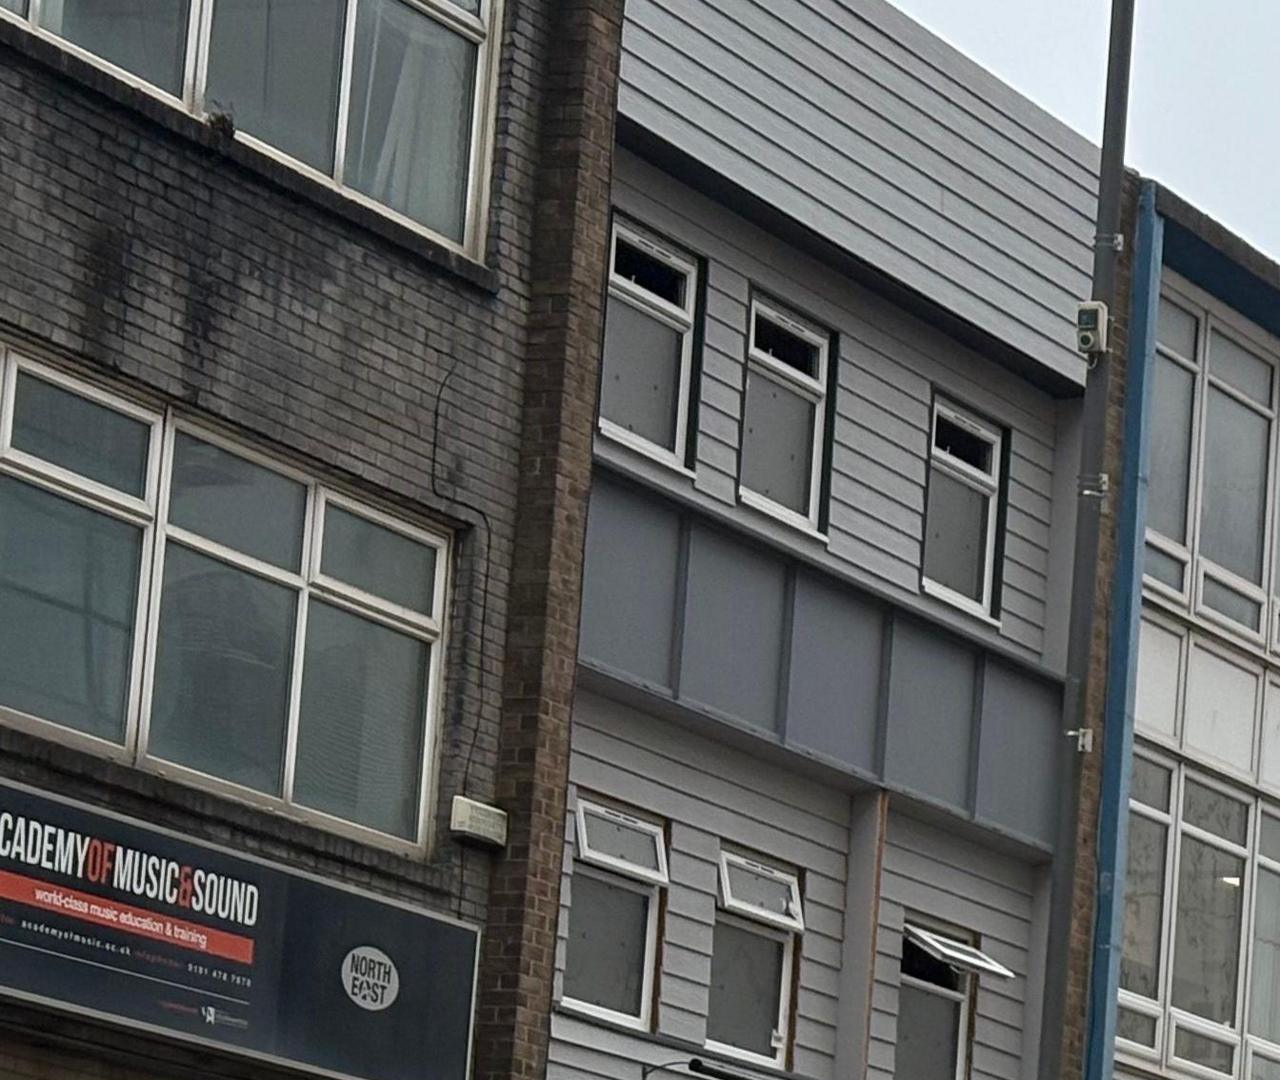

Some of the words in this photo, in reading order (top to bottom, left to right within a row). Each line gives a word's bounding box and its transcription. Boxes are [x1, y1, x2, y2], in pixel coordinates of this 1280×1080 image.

[35, 889, 88, 914] world-class
[90, 901, 118, 921] music
[119, 909, 163, 933] education
[165, 922, 174, 937] &
[173, 925, 208, 950] training
[351, 952, 392, 984] NORTH
[351, 976, 388, 1005] EAST
